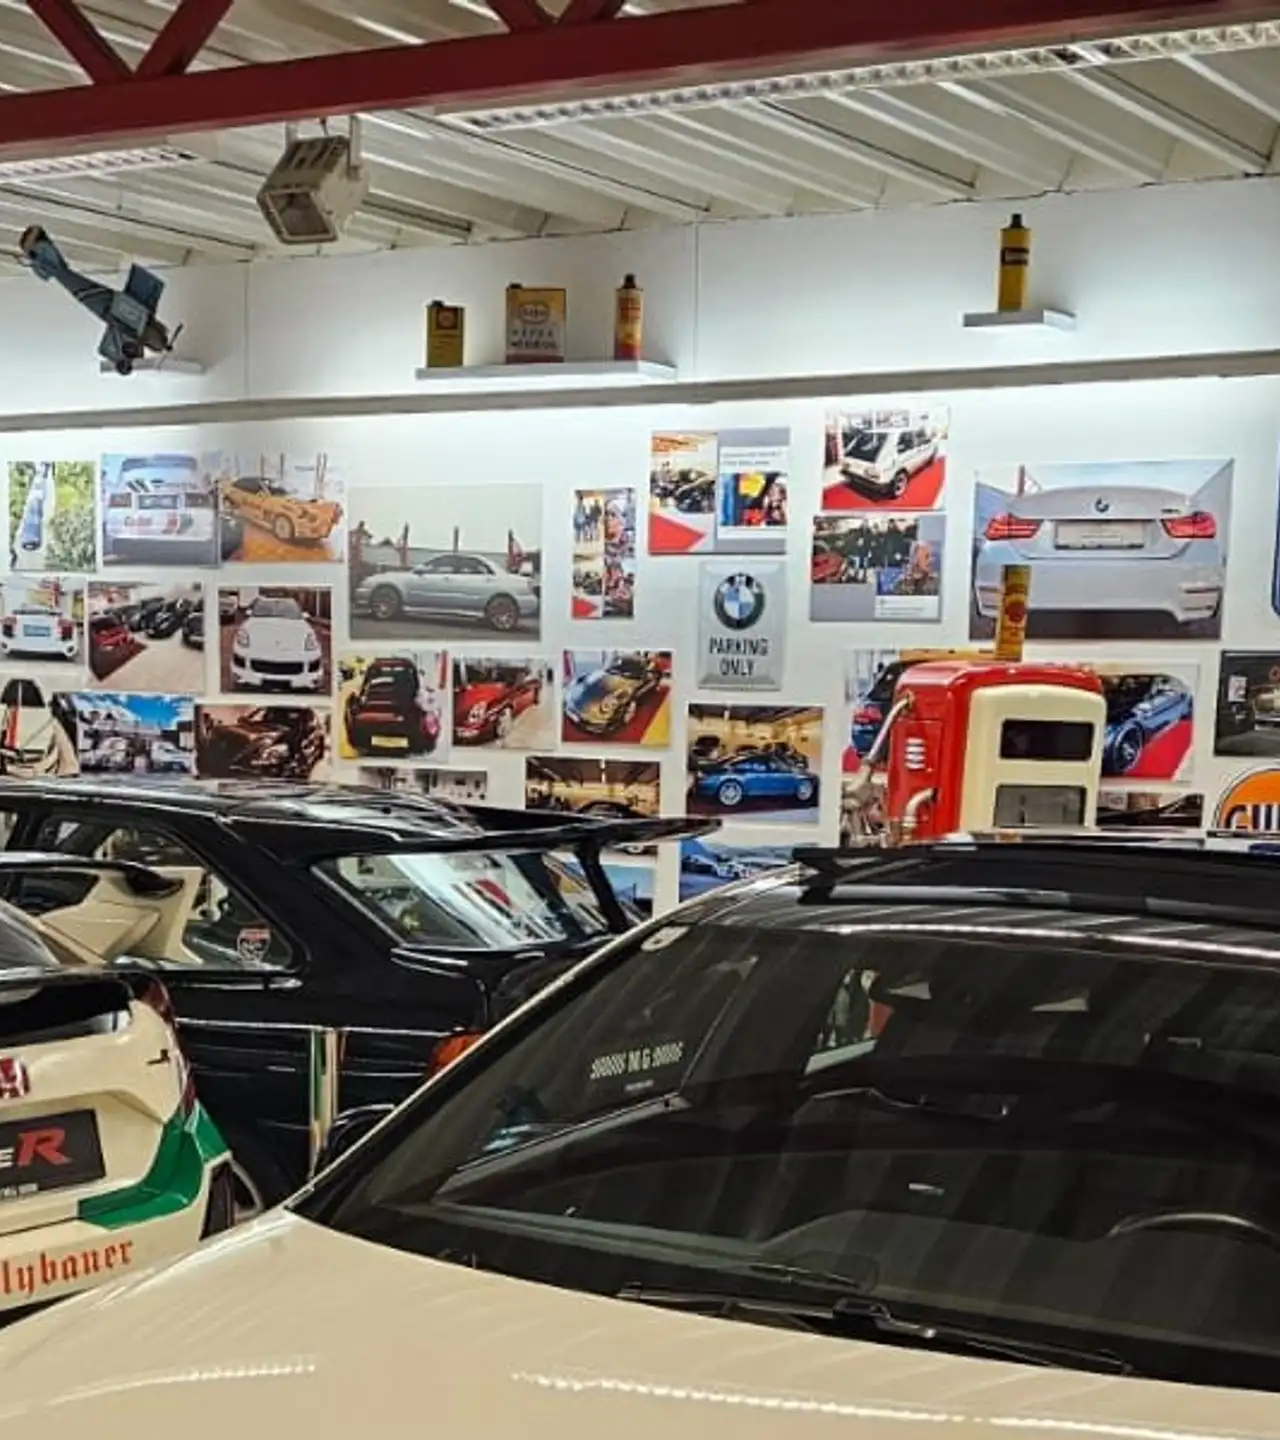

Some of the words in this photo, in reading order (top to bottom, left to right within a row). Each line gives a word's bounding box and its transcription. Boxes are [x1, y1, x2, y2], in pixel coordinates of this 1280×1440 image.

[708, 636, 769, 657] PARKING
[719, 657, 755, 677] ONLY
[15, 1126, 71, 1167] R
